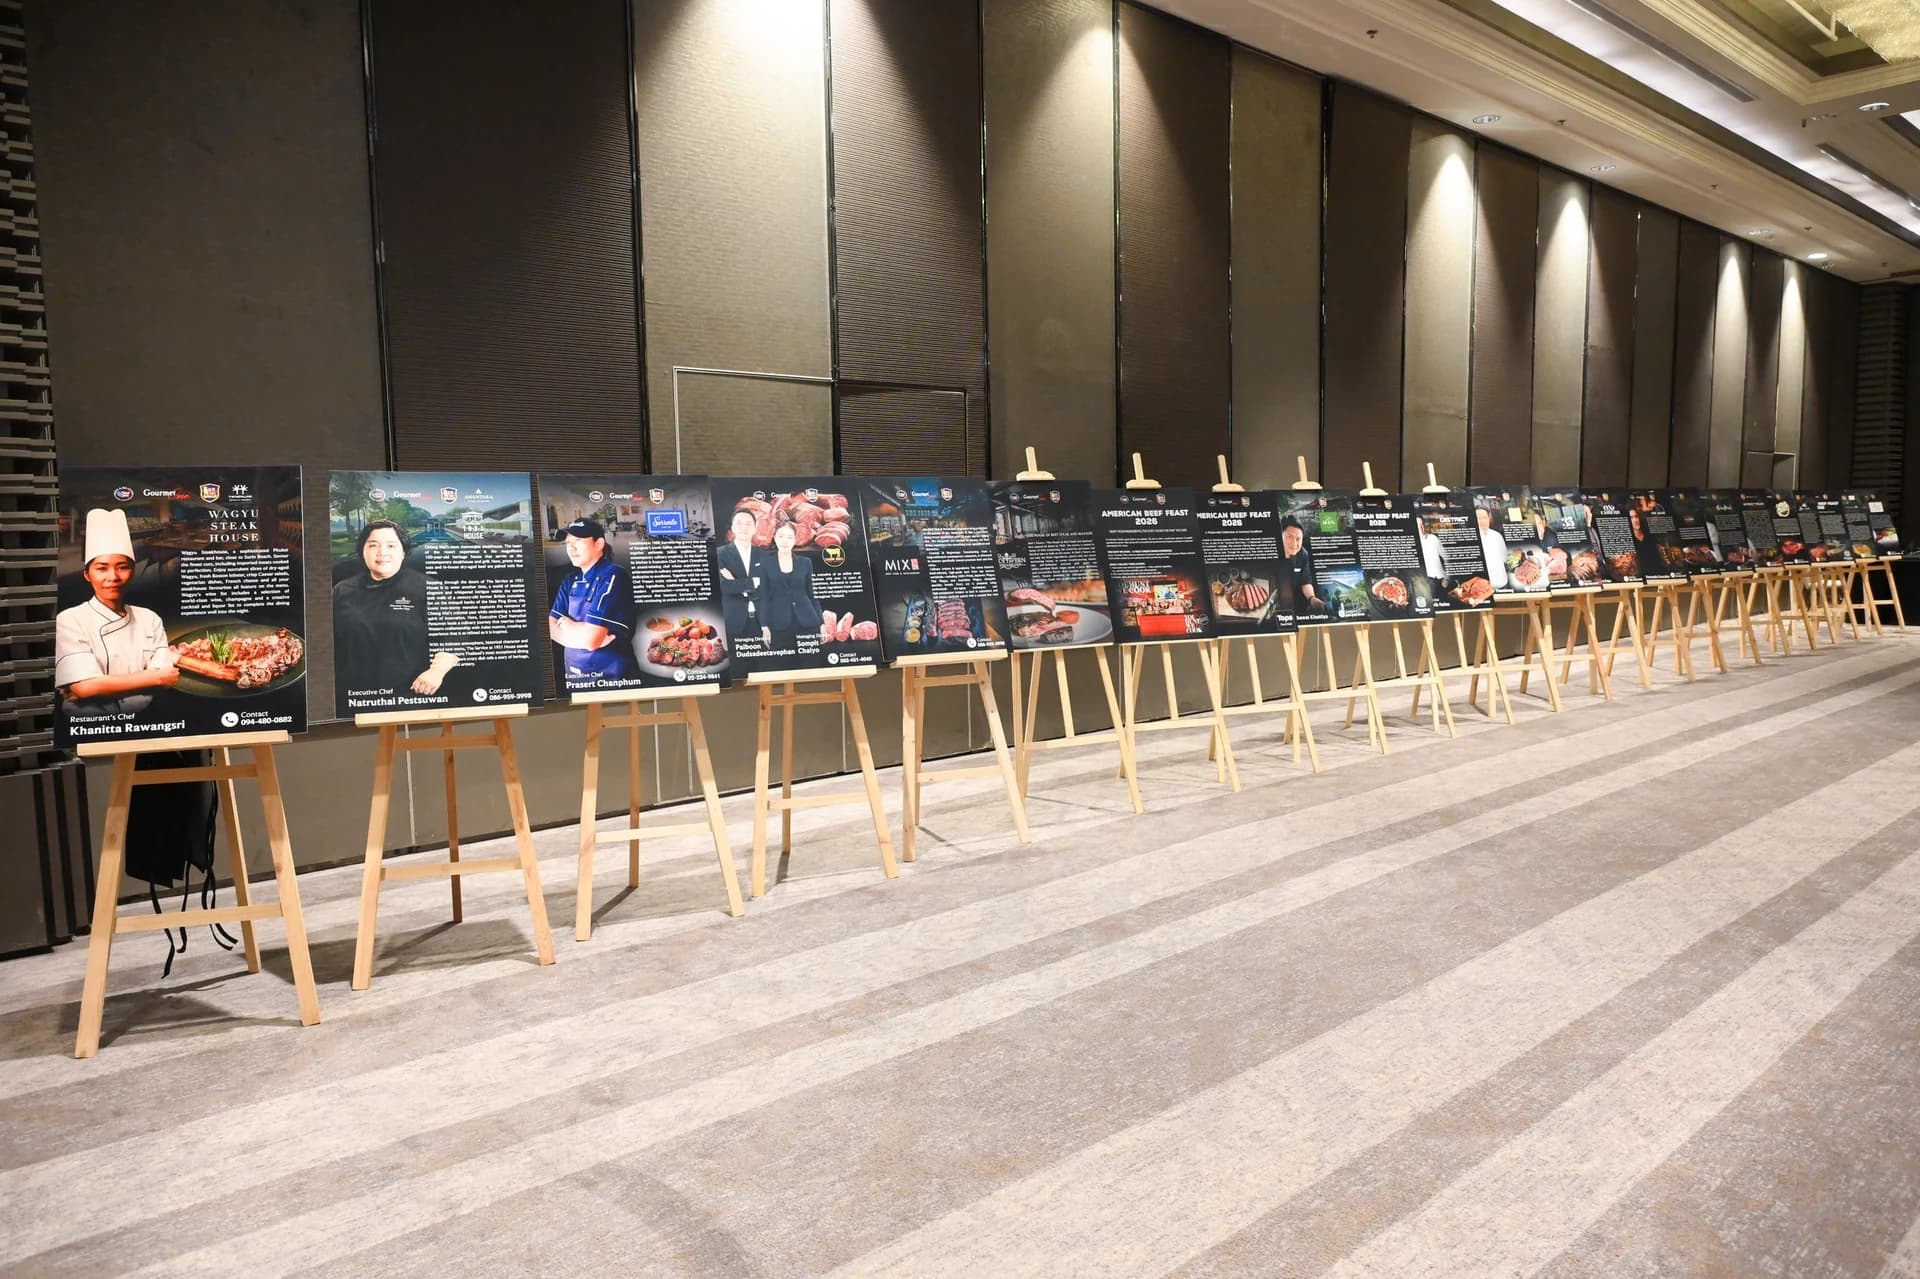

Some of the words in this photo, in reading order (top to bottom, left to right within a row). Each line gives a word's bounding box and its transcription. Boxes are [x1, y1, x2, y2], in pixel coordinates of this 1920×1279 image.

[209, 509, 260, 519] WAGYU
[210, 522, 258, 530] STEAK
[209, 533, 259, 543] HOUSE
[566, 680, 596, 689] Prasert
[597, 679, 641, 688] Chanphum
[398, 695, 448, 705] Pestsuwan
[70, 714, 116, 722] Restaurant's
[70, 722, 121, 736] Khanitta
[125, 720, 185, 733] Rawangsri
